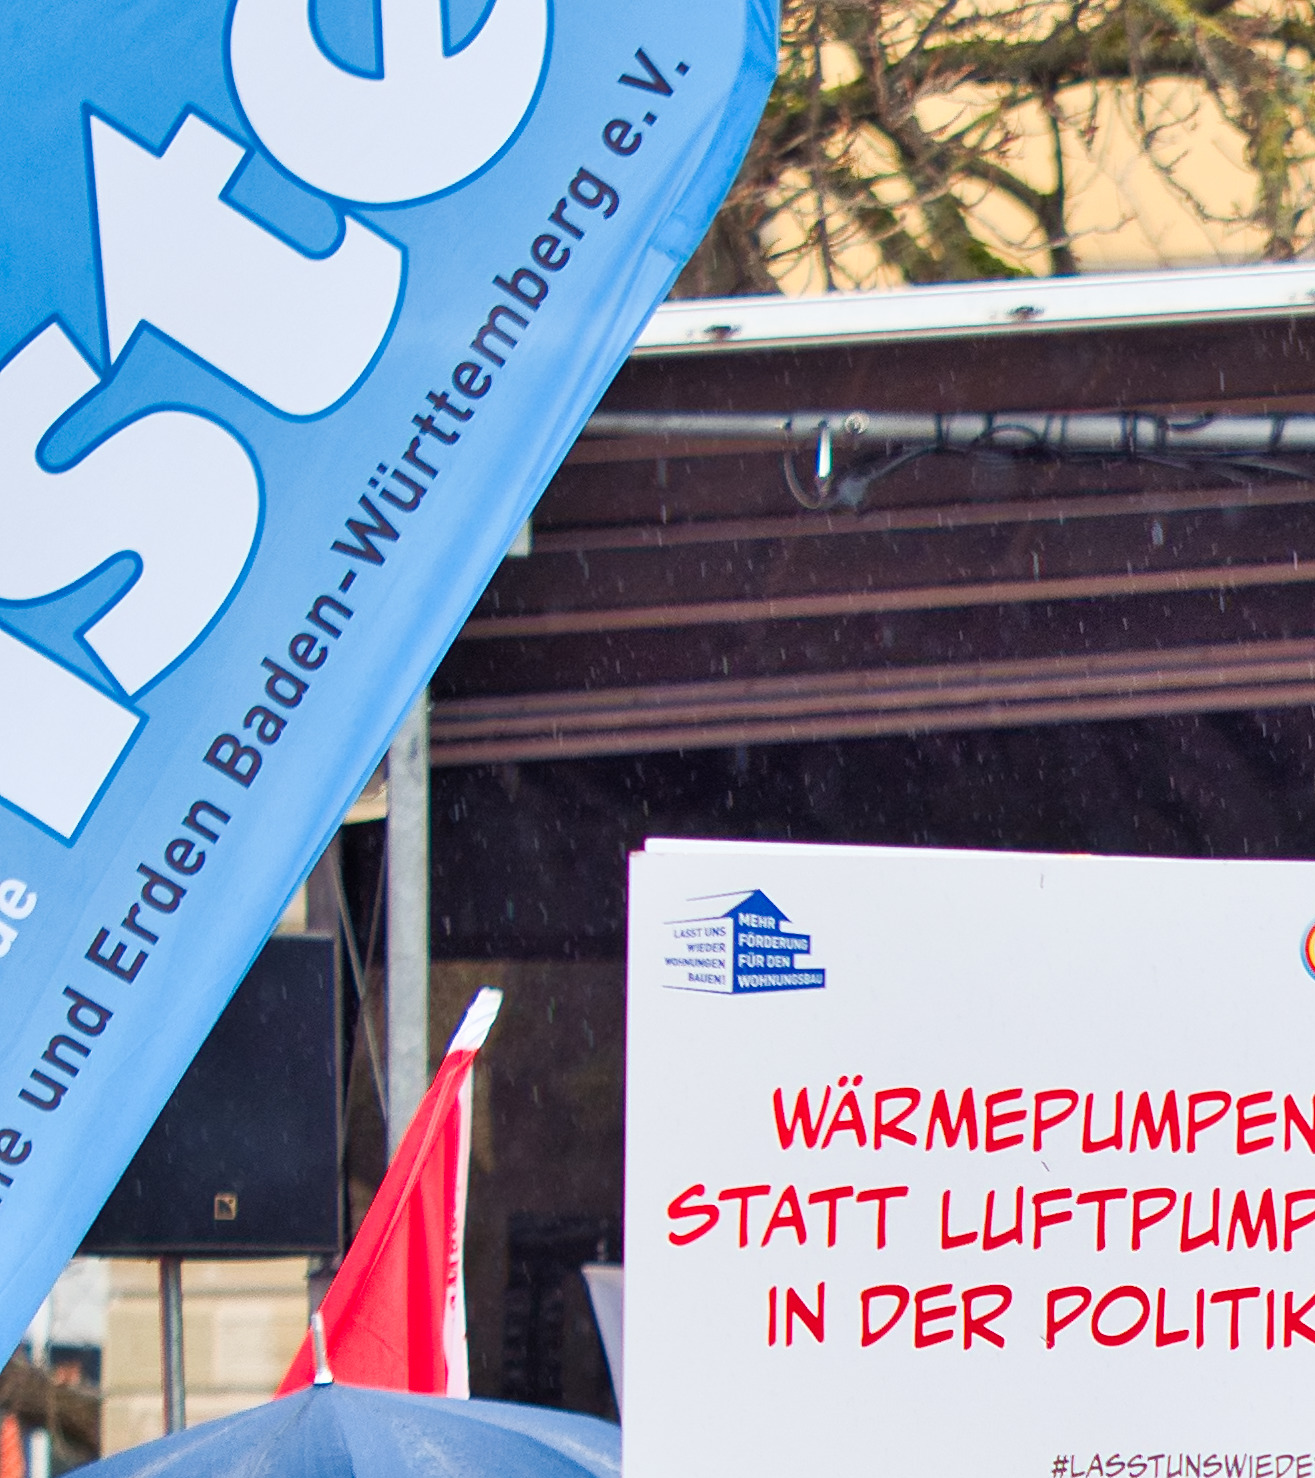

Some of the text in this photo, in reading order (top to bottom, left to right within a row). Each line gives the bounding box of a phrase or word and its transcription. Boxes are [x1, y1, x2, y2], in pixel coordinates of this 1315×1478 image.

[18, 985, 114, 1112] und
[84, 799, 231, 983] Erden
[202, 166, 620, 788] Baden-Württemberg
[738, 912, 776, 930] MEHR
[738, 931, 809, 951] FÖRDERUNG
[738, 952, 791, 969] FÜR DEN
[737, 973, 824, 989] WOHNUNGSBAU
[667, 1183, 910, 1250] STATT
[767, 1281, 826, 1347] IN
[860, 1283, 1013, 1351] DER
